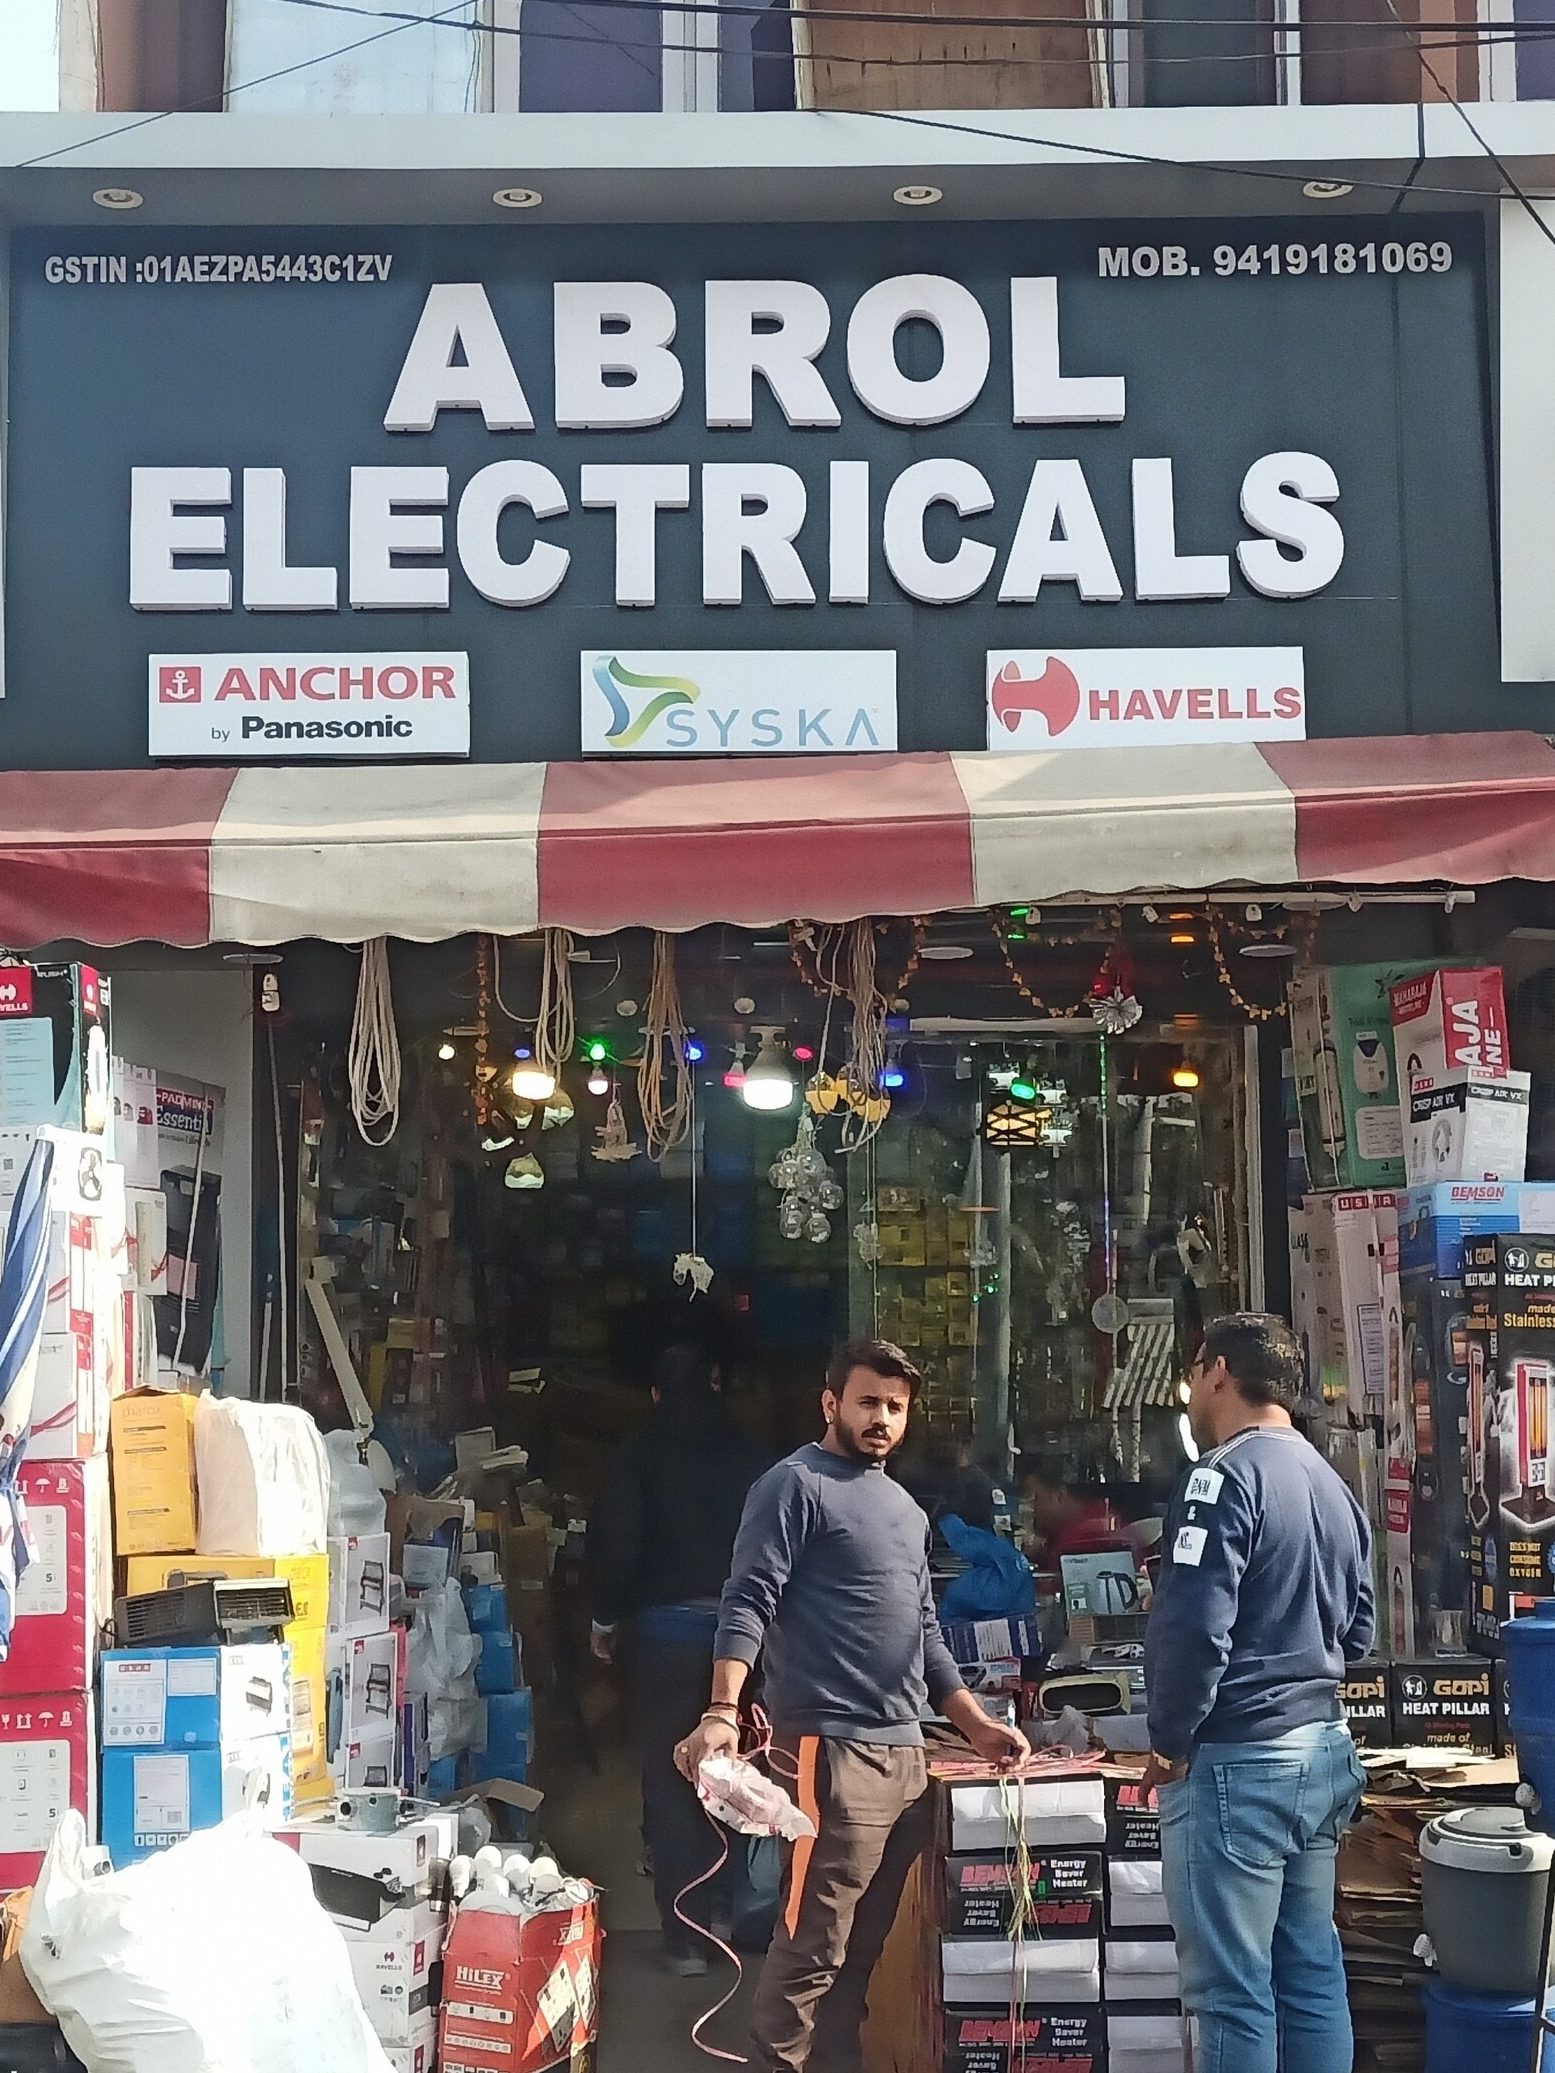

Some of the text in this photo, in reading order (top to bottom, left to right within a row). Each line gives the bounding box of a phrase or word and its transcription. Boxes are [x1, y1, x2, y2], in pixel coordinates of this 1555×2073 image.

[1097, 241, 1454, 278] MOB. 9419181069
[45, 255, 127, 284] GSTIN
[384, 273, 1126, 432] ABROL
[130, 450, 1345, 611] ELECTRICALS
[214, 666, 457, 702] ANCHOR
[1088, 687, 1302, 721] HAVELLS
[211, 715, 414, 742] by Panasonic
[666, 708, 880, 748] SYSKA
[0, 1002, 29, 1012] VELLS
[1451, 1186, 1505, 1199] BEMSON
[1339, 1194, 1391, 1209] USA
[1504, 1273, 1541, 1287] HEAT
[45, 1573, 52, 1582] 5
[1346, 1704, 1386, 1718] ILLAR
[1403, 1703, 1437, 1715] HEAT
[1442, 1702, 1490, 1715] PILLAR
[1427, 1733, 1456, 1743] made
[49, 1808, 56, 1818] 5
[1050, 2017, 1088, 2028] Energy
[1052, 2038, 1088, 2047] Heater
